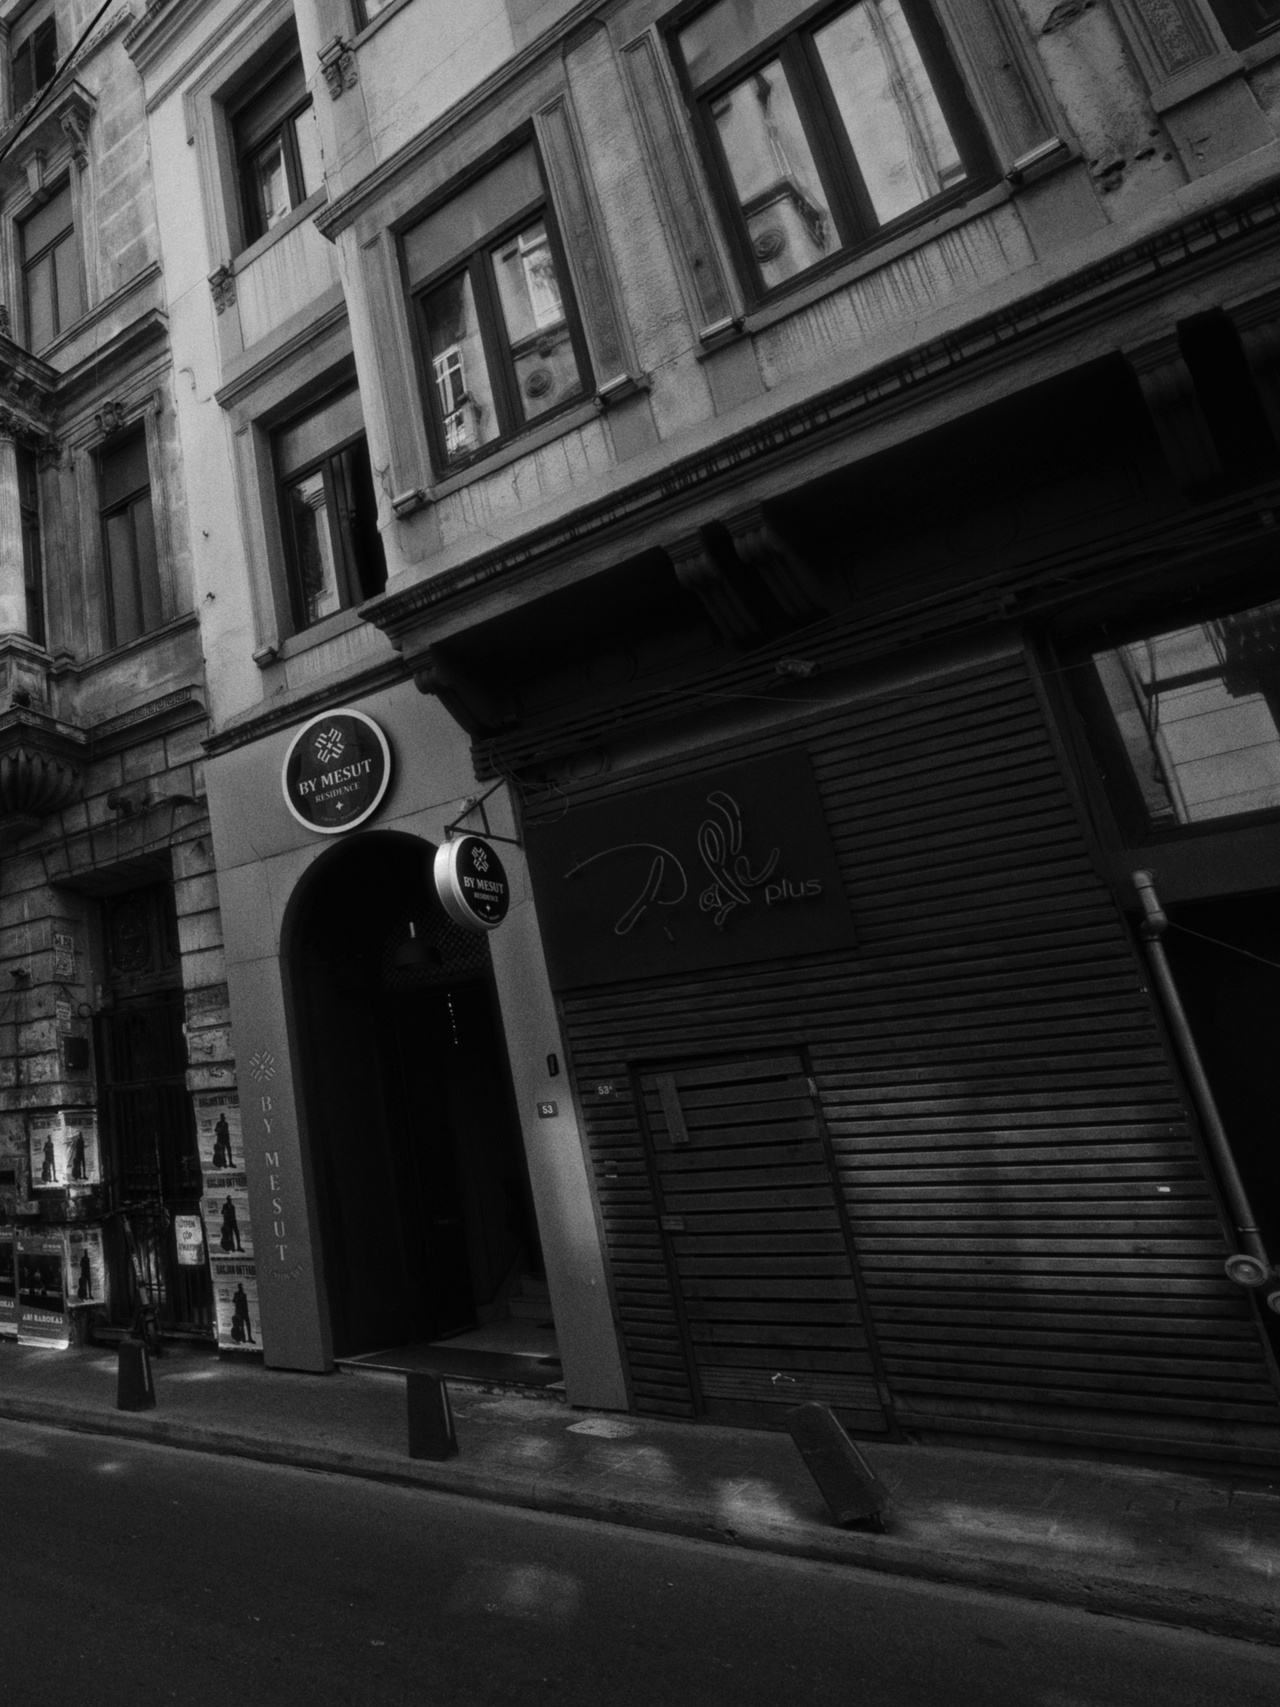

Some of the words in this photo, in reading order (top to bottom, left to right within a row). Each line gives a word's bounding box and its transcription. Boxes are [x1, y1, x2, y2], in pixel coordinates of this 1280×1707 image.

[298, 777, 317, 796] BY
[320, 758, 372, 789] MESUT
[314, 781, 360, 803] RESIDENCE
[463, 875, 475, 888] BY
[476, 878, 504, 894] MESUT
[765, 878, 821, 905] plus
[542, 1104, 554, 1115] 53
